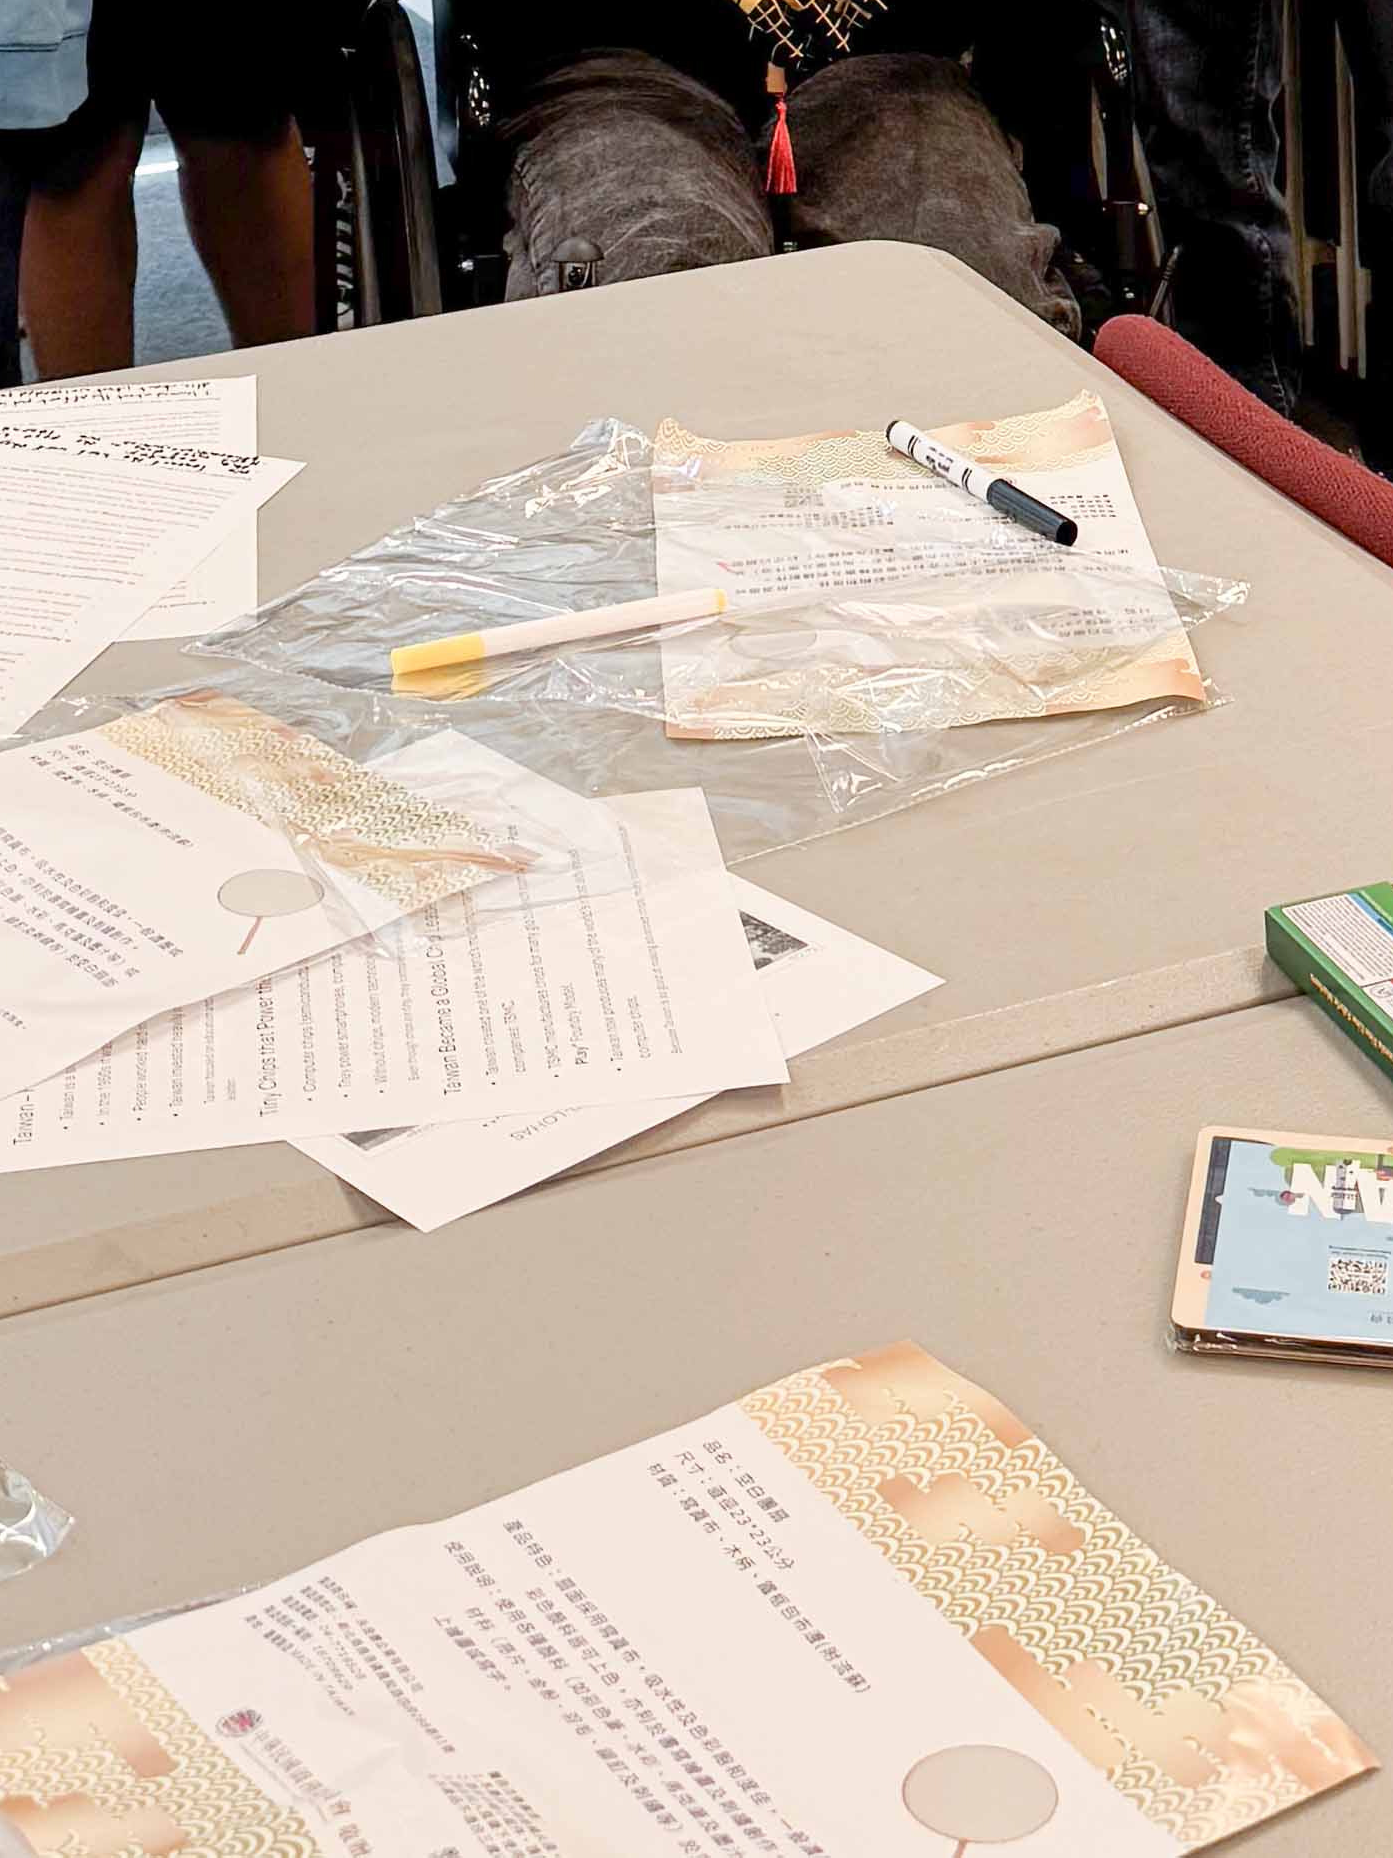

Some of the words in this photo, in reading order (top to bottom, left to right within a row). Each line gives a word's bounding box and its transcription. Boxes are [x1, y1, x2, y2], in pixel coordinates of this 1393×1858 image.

[429, 958, 449, 998] Global
[255, 994, 275, 1030] Power
[437, 997, 451, 1007] a
[259, 1030, 275, 1055] that
[437, 1006, 456, 1053] Became
[257, 1056, 278, 1090] Chips
[441, 1054, 461, 1095] Taiwan
[258, 1091, 282, 1116] Tiny
[12, 1102, 33, 1145] Taiwan
